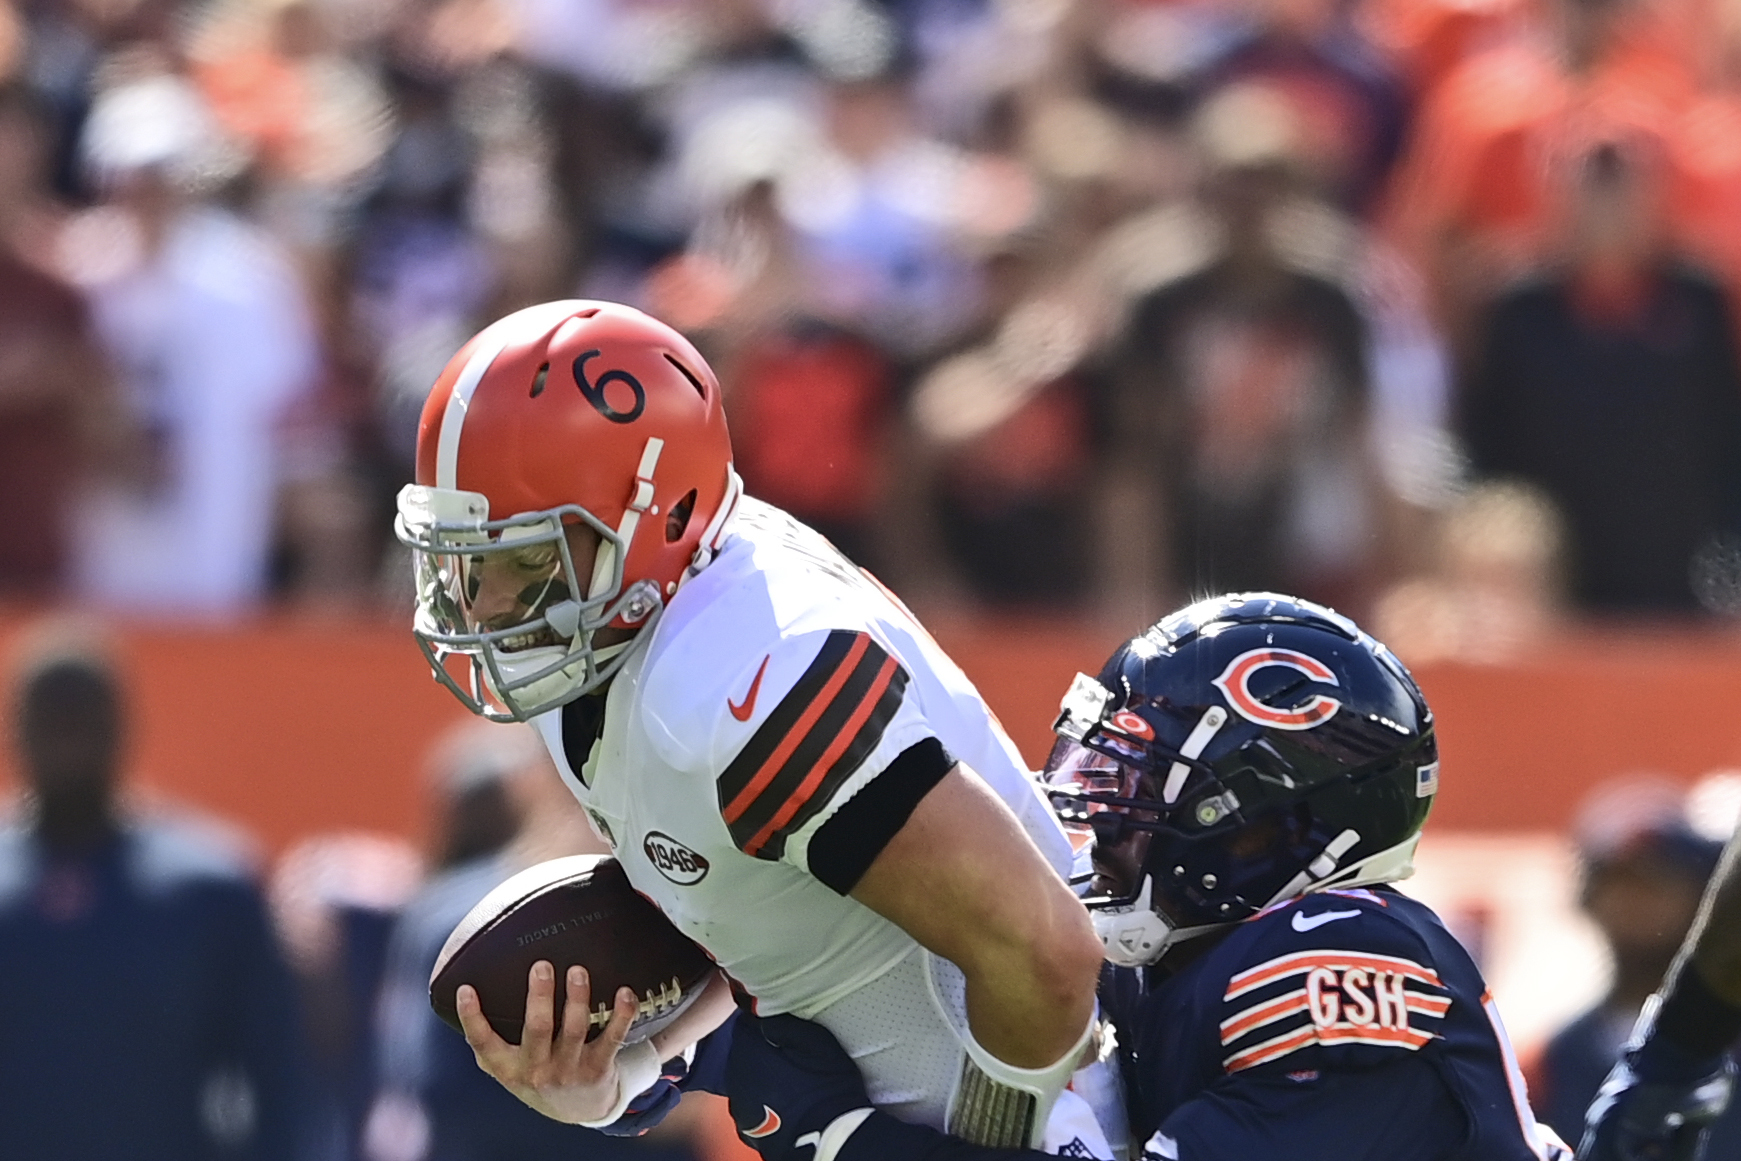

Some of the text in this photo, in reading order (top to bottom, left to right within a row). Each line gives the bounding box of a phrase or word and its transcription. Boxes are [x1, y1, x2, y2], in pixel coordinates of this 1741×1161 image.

[572, 349, 646, 424] 6
[1210, 647, 1342, 731] C
[650, 841, 698, 873] 1946
[516, 922, 567, 947] LEAGUE
[1306, 966, 1409, 1031] GSH
